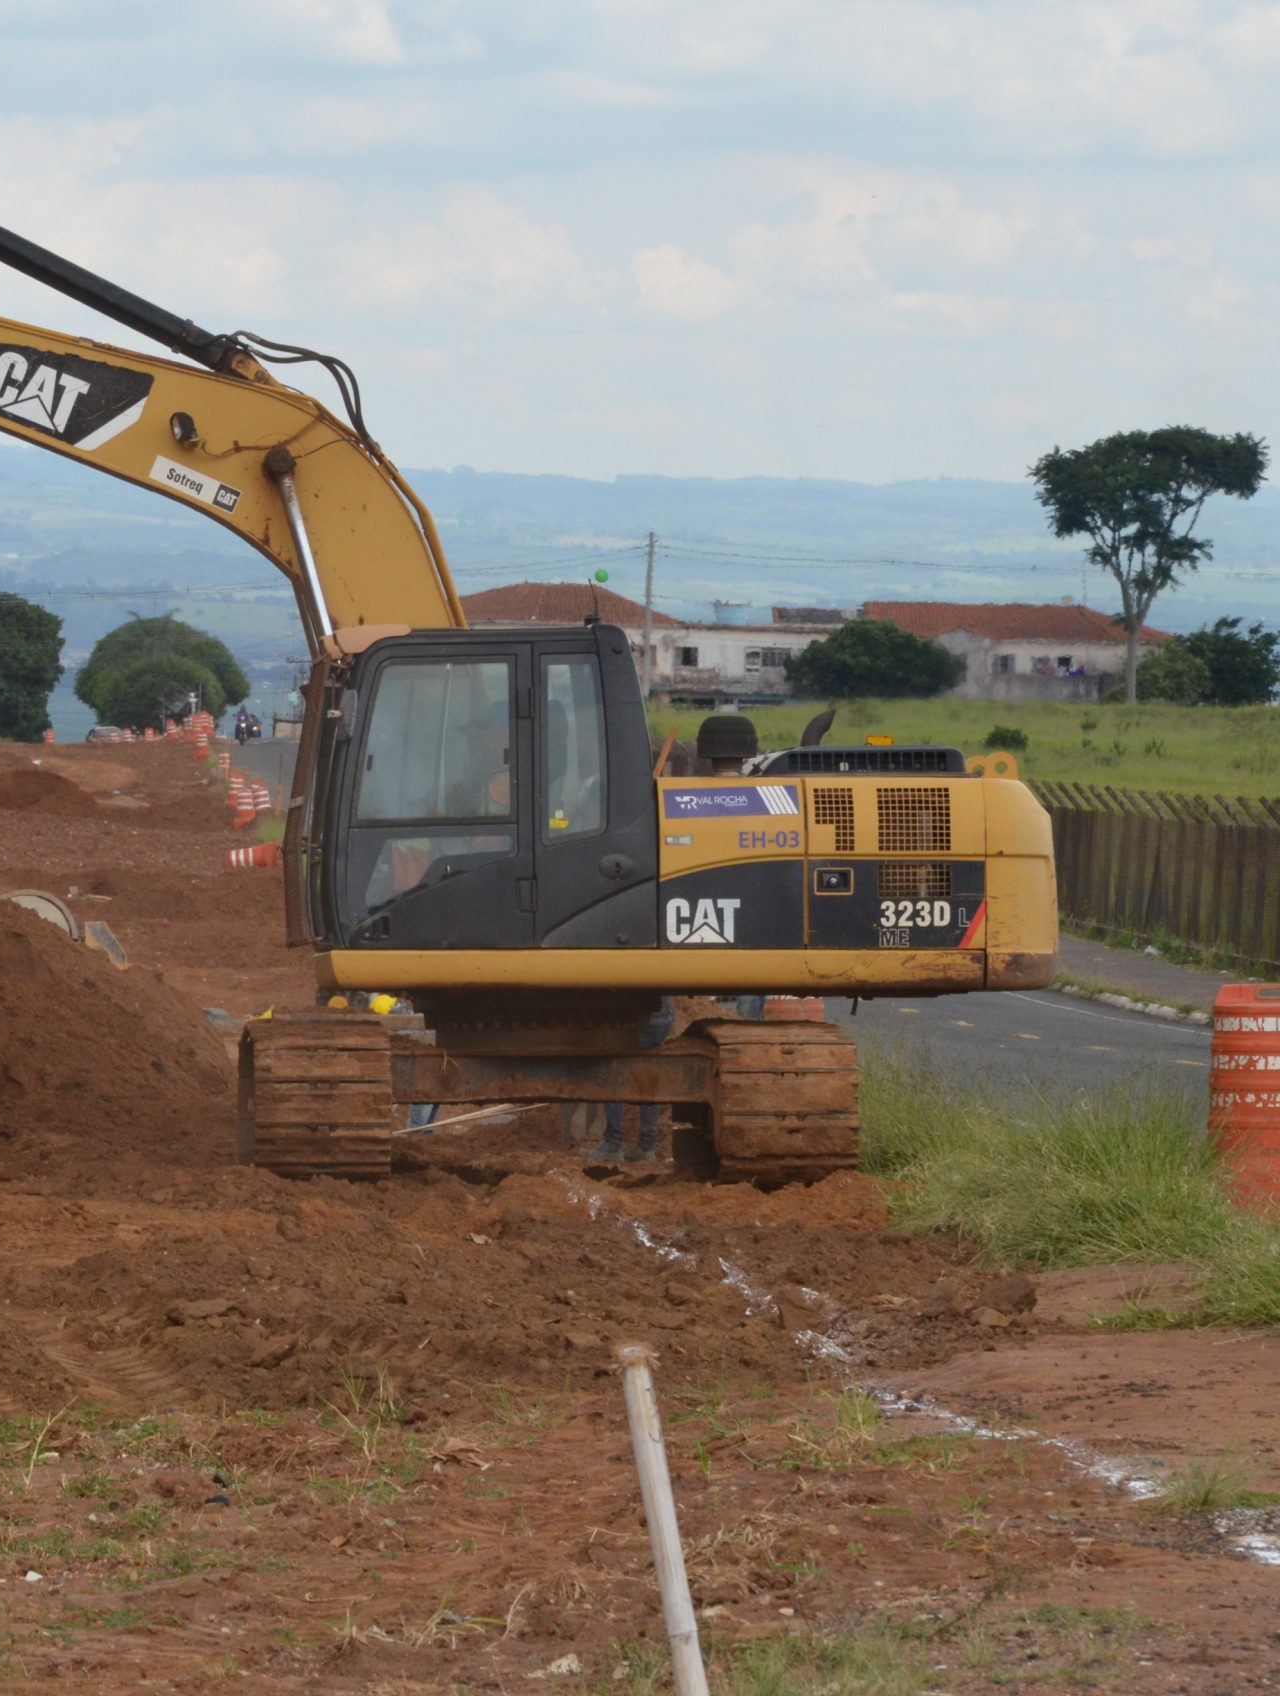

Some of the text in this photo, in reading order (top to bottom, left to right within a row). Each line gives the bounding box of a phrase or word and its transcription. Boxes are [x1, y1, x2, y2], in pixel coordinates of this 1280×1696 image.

[166, 468, 239, 507] Sotreq CAT
[696, 796, 714, 806] VAL
[714, 794, 748, 805] ROCHA
[738, 831, 800, 849] EH-03
[666, 897, 741, 944] CAT
[880, 900, 951, 928] 323D
[879, 928, 910, 948] ME
